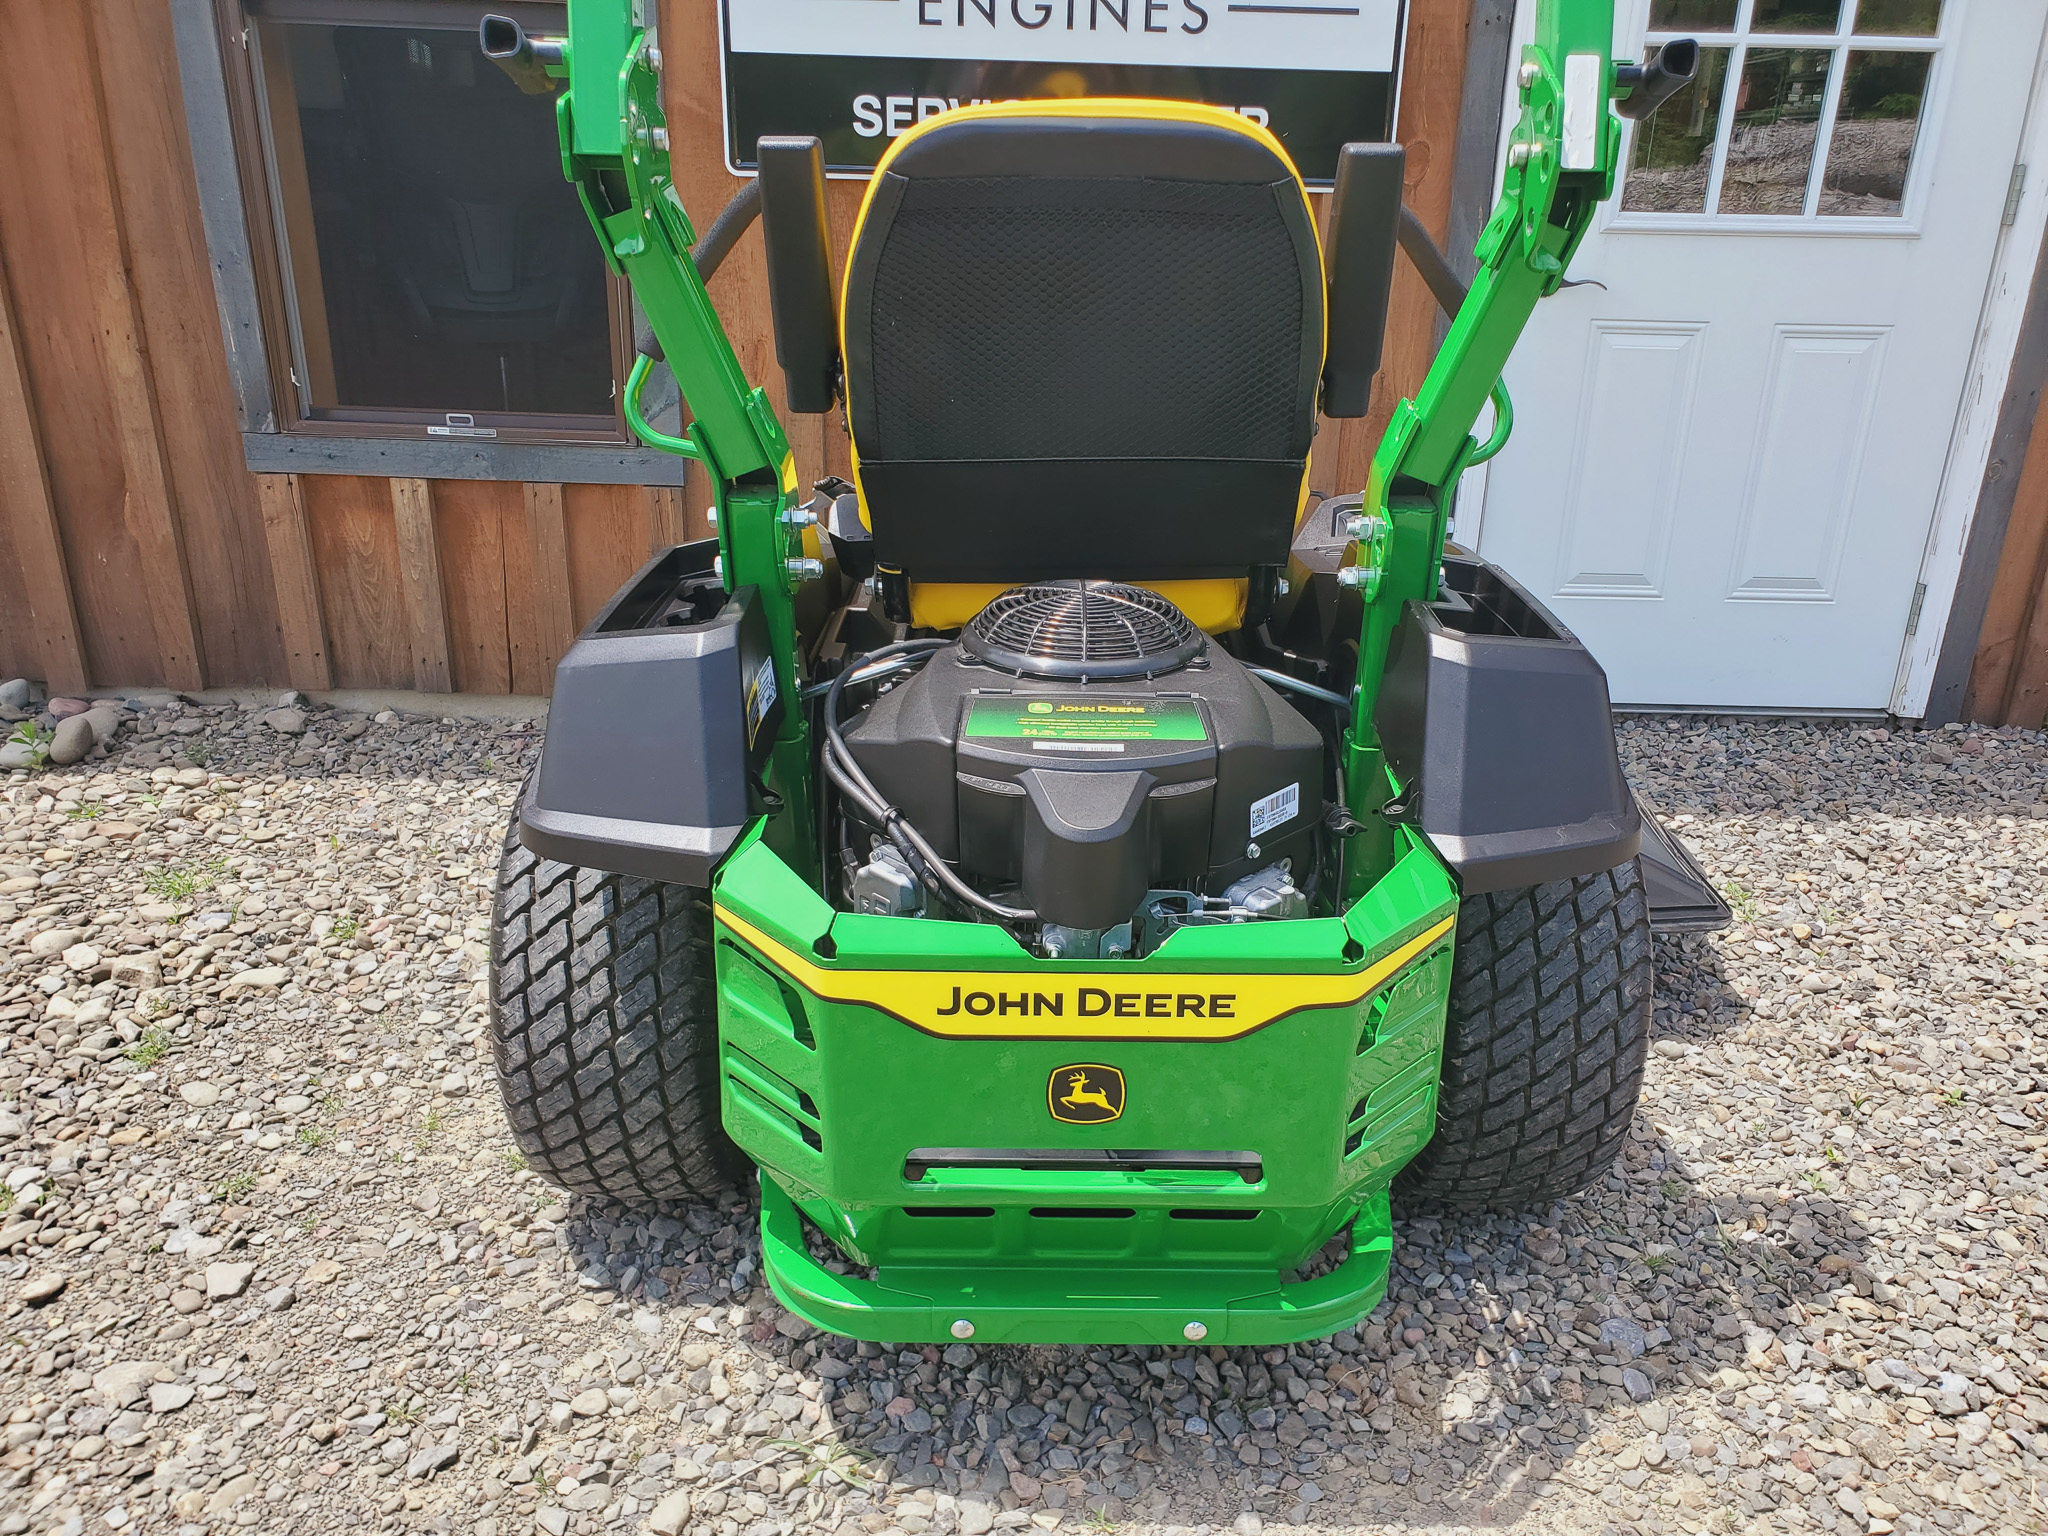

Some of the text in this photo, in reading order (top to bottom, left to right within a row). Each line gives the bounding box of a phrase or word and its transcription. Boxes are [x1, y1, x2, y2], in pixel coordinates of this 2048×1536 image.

[918, 0, 1209, 35] ENGINES
[1056, 704, 1146, 714] JOHN DEERE
[936, 986, 1237, 1019] JOHN DEERE
